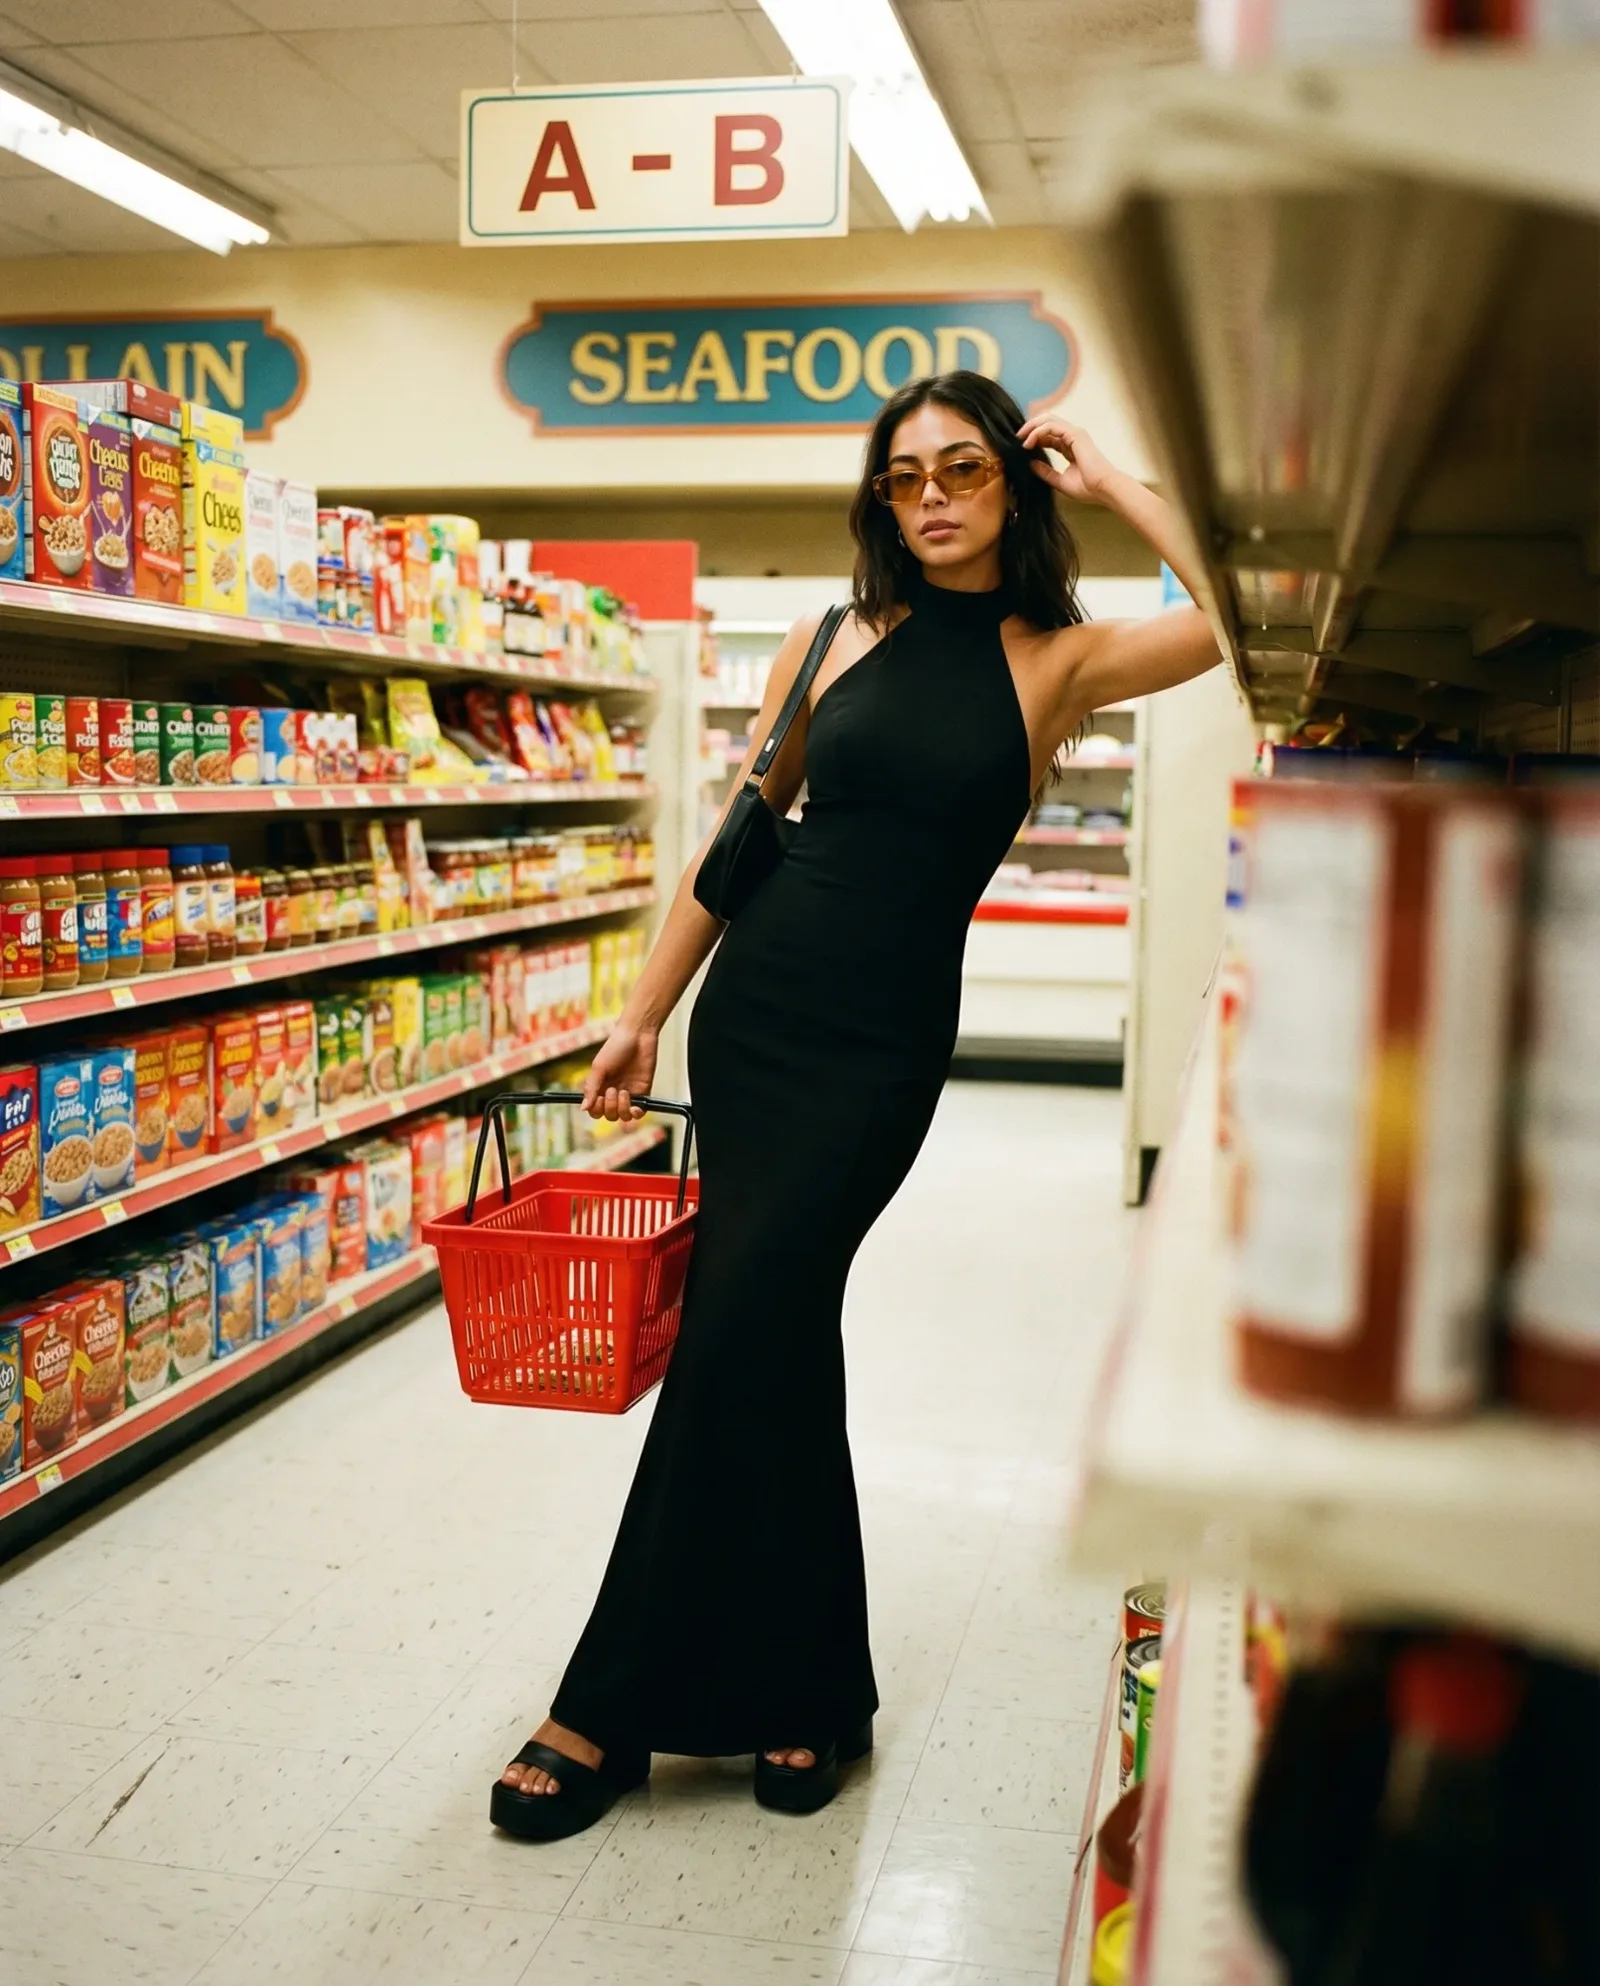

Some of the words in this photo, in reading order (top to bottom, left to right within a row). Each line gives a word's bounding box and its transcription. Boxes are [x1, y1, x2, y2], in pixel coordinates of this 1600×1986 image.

[519, 121, 596, 211] A
[714, 114, 784, 206] B
[568, 325, 1002, 405] SEAFOOD
